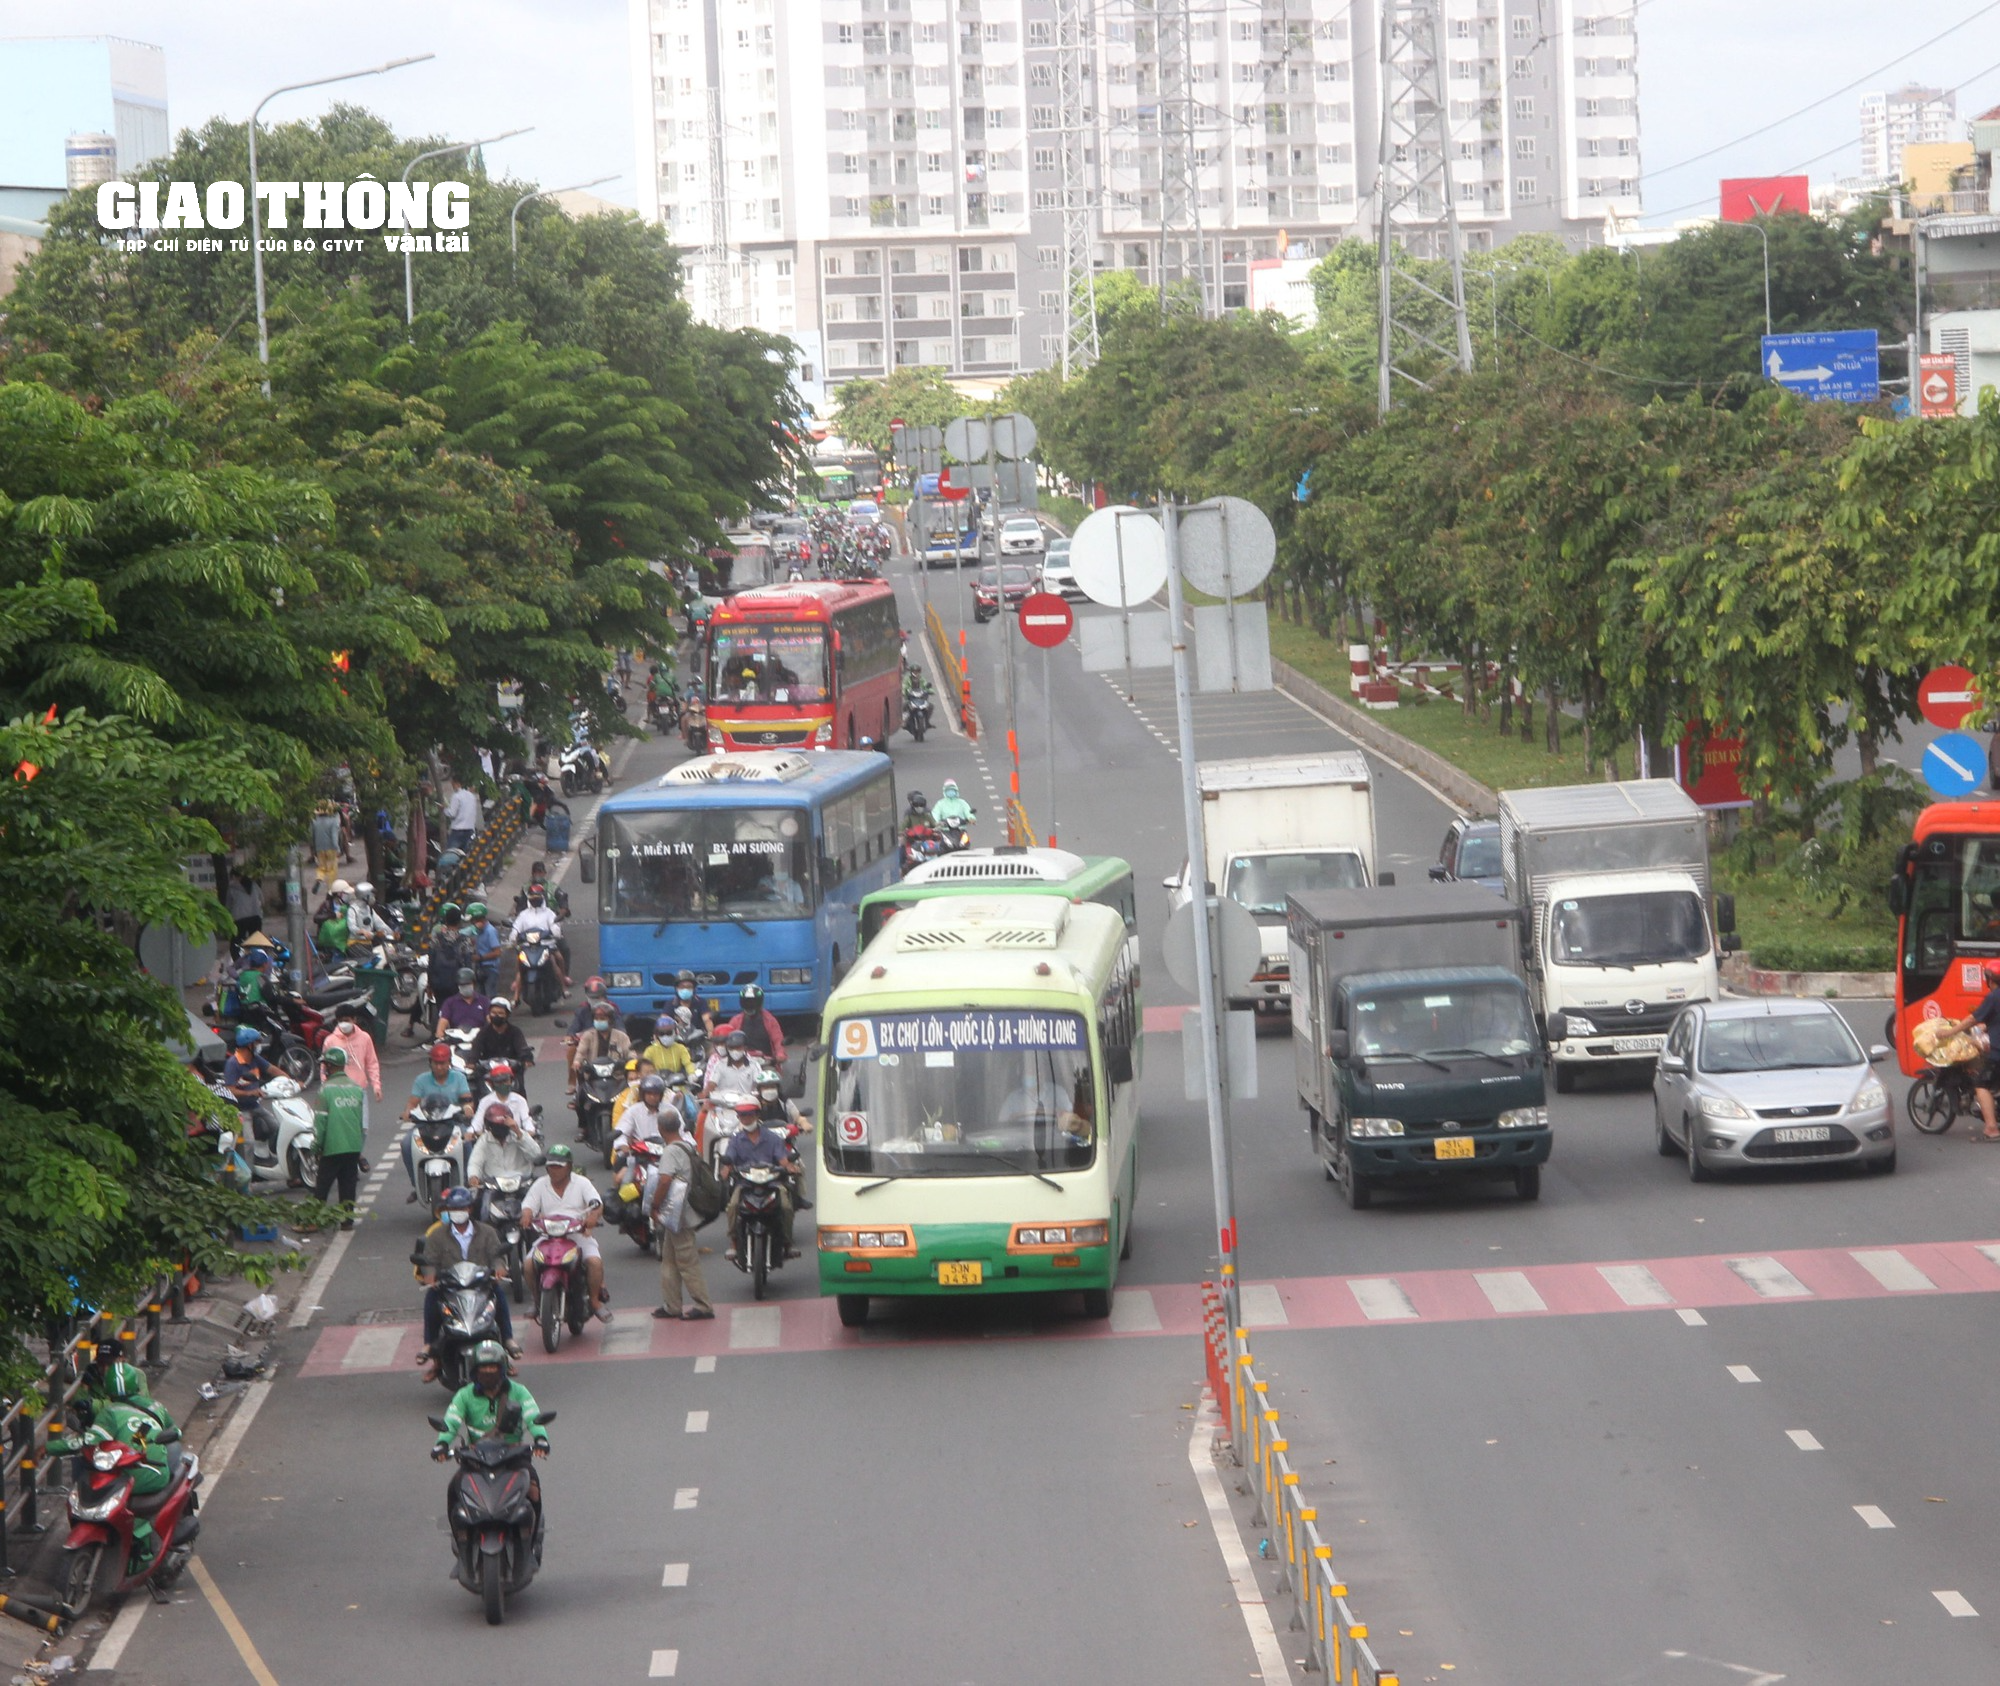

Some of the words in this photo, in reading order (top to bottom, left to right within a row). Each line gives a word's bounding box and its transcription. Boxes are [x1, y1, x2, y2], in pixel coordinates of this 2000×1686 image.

[673, 841, 695, 855] TÂY
[732, 843, 747, 854] AN
[749, 841, 784, 854] SƯƠNG
[845, 1022, 869, 1056] 9
[880, 1022, 895, 1048] BX
[897, 1018, 920, 1051] CHỢ
[950, 1012, 979, 1050] QUỐC
[981, 1014, 996, 1050] LỘ
[999, 1019, 1012, 1045] 1A
[1049, 1019, 1077, 1046] LONG
[335, 1095, 359, 1108] Grab
[844, 1119, 864, 1141] 9
[950, 1263, 970, 1274] 53N
